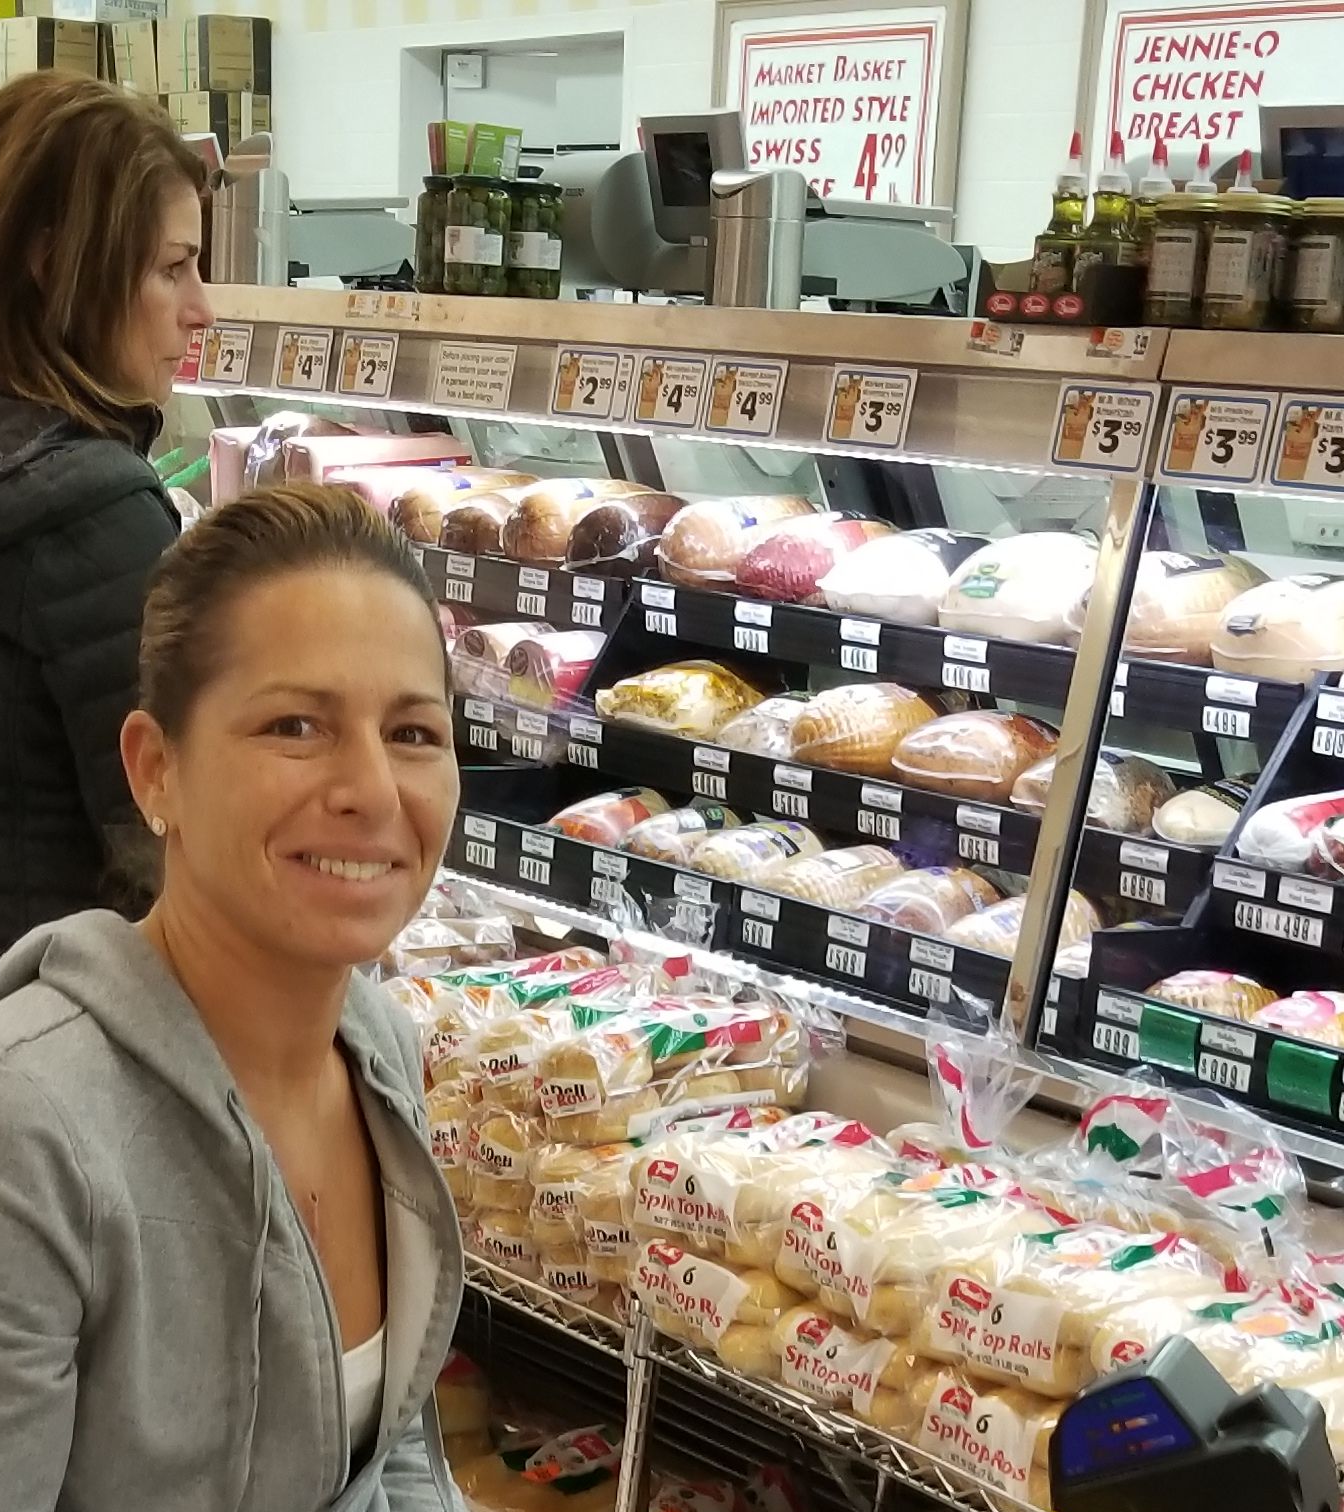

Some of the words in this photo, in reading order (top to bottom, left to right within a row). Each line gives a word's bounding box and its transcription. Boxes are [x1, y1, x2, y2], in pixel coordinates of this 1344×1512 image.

[1134, 30, 1280, 64] JENNIE-O
[754, 62, 825, 87] MARKET
[833, 55, 907, 82] BASKET
[1132, 70, 1265, 102] CHICKEN
[750, 96, 845, 126] IMPORTED
[852, 95, 911, 122] STYLE
[1127, 110, 1244, 140] BREAST
[749, 138, 822, 165] SWISS
[685, 1174, 696, 1196] 6
[677, 1196, 705, 1222] Top
[683, 1266, 697, 1286] 6
[991, 1303, 1004, 1325] 6
[939, 1310, 976, 1342] Split
[1009, 1335, 1052, 1361] Rolls
[976, 1414, 993, 1434] 6
